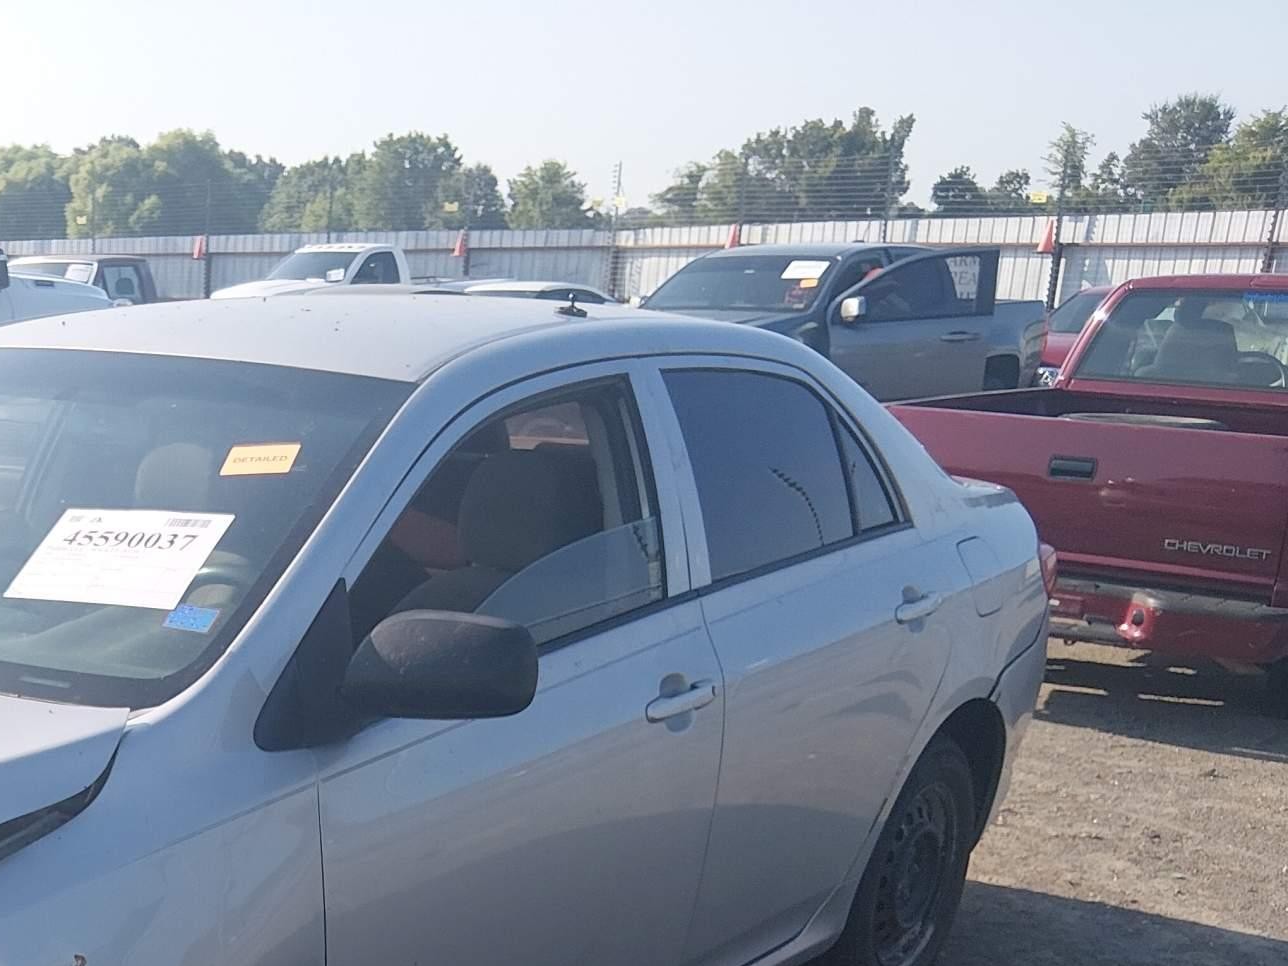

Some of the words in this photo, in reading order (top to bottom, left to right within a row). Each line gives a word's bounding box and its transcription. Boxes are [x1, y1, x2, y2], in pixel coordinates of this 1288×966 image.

[233, 455, 288, 464] DETAILED
[63, 529, 199, 551] 45590037
[1164, 538, 1272, 560] CHEVROLET
